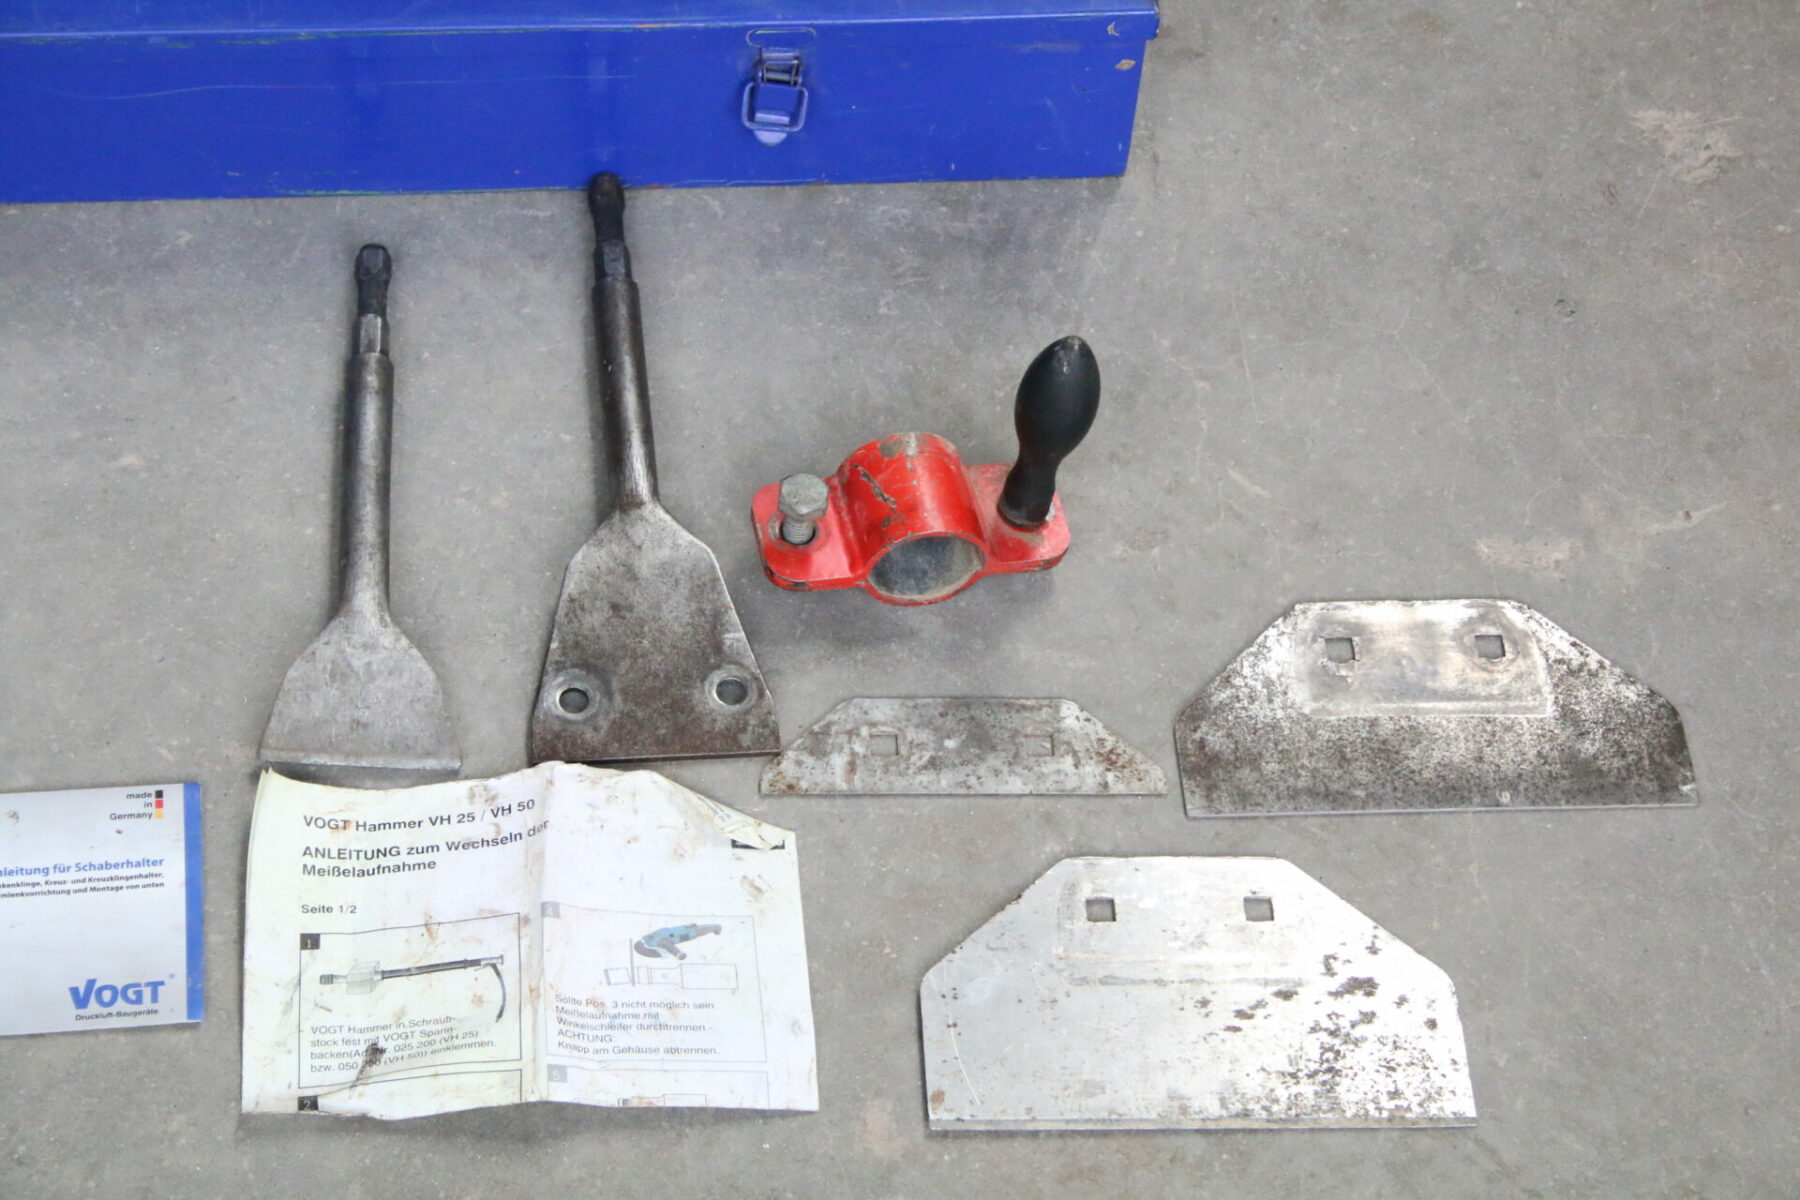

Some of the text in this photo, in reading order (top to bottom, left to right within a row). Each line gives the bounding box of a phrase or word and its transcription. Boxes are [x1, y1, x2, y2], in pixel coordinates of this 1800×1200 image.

[110, 812, 152, 820] Germany
[303, 799, 535, 832] VOGT Hammer VH 25 / VH 50
[302, 820, 549, 860] ANLEITUNG zum Wechseln der
[53, 864, 71, 874] für
[74, 858, 164, 872] Schaberhalter
[302, 860, 436, 878] Meißelaufnahme
[88, 872, 164, 883] Kreuzklingenhalter,
[90, 886, 124, 894] Montage
[301, 904, 357, 914] Seite 1/2
[68, 978, 165, 1010] VOGT
[555, 994, 583, 1006] Sollte
[621, 1000, 646, 1008] nicht
[649, 1001, 690, 1010] möglich
[75, 1008, 158, 1021] Druckluft-Baugeräte
[555, 1005, 640, 1019] Meißelaufnahme
[310, 1025, 344, 1034] VOGT
[348, 1023, 391, 1034] Hammer
[408, 1016, 456, 1028] Schraub-
[556, 1016, 706, 1031] Winkelschleifer durchtrennen
[310, 1038, 338, 1047] stock
[342, 1038, 360, 1046] fest
[364, 1036, 379, 1044] mit
[383, 1031, 415, 1042] VOGT
[394, 1043, 413, 1052] 025
[416, 1039, 436, 1049] 200
[439, 1033, 458, 1044] (VH
[461, 1030, 478, 1040] 25)
[558, 1041, 590, 1054] Knapp
[612, 1046, 660, 1054] Gehäuse
[310, 1062, 334, 1072] bzw.
[338, 1062, 358, 1071] 050
[384, 1055, 404, 1065] (VH
[430, 1040, 497, 1055] einklemmen.
